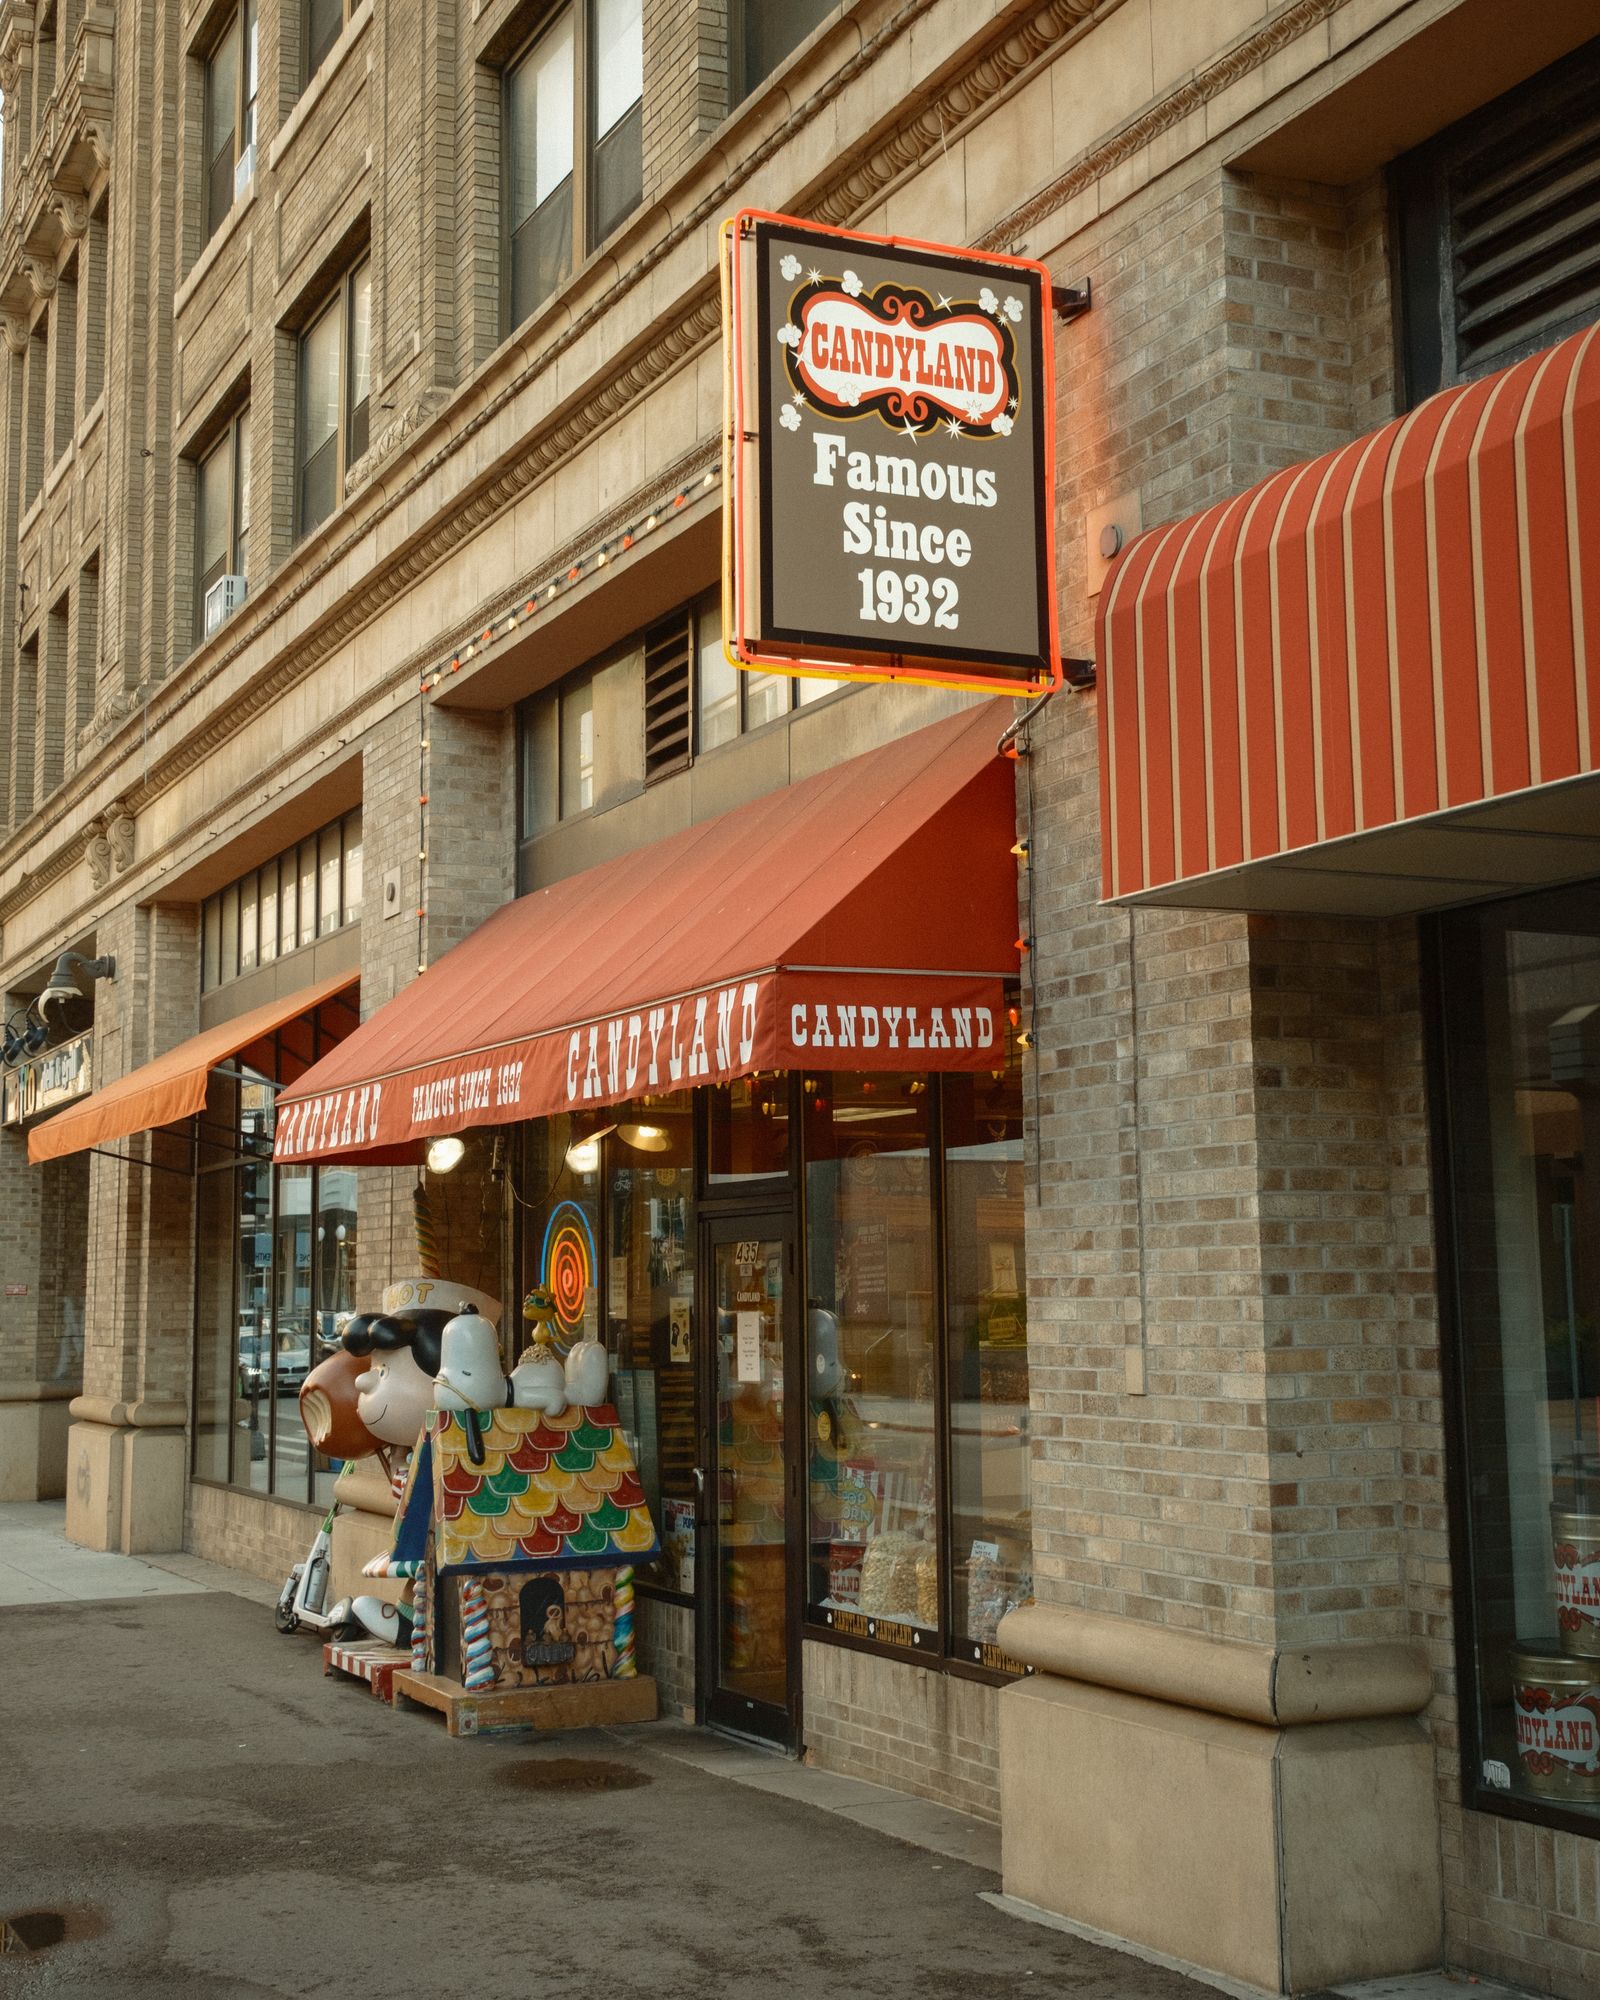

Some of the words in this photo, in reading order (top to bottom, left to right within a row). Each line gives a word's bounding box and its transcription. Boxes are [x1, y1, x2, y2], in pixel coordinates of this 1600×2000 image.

[811, 322, 996, 395] CANDYLAND
[813, 432, 997, 507] Famous
[843, 501, 972, 567] Since
[858, 568, 959, 630] 1932
[566, 982, 759, 1101] CANDYLAND
[791, 1004, 994, 1048] CANDYLAND
[275, 1083, 382, 1157] CANDYLAND
[411, 1076, 456, 1123] FAMOUS
[459, 1068, 492, 1113] SINCE
[496, 1061, 523, 1106] 1932
[737, 1243, 758, 1262] 435
